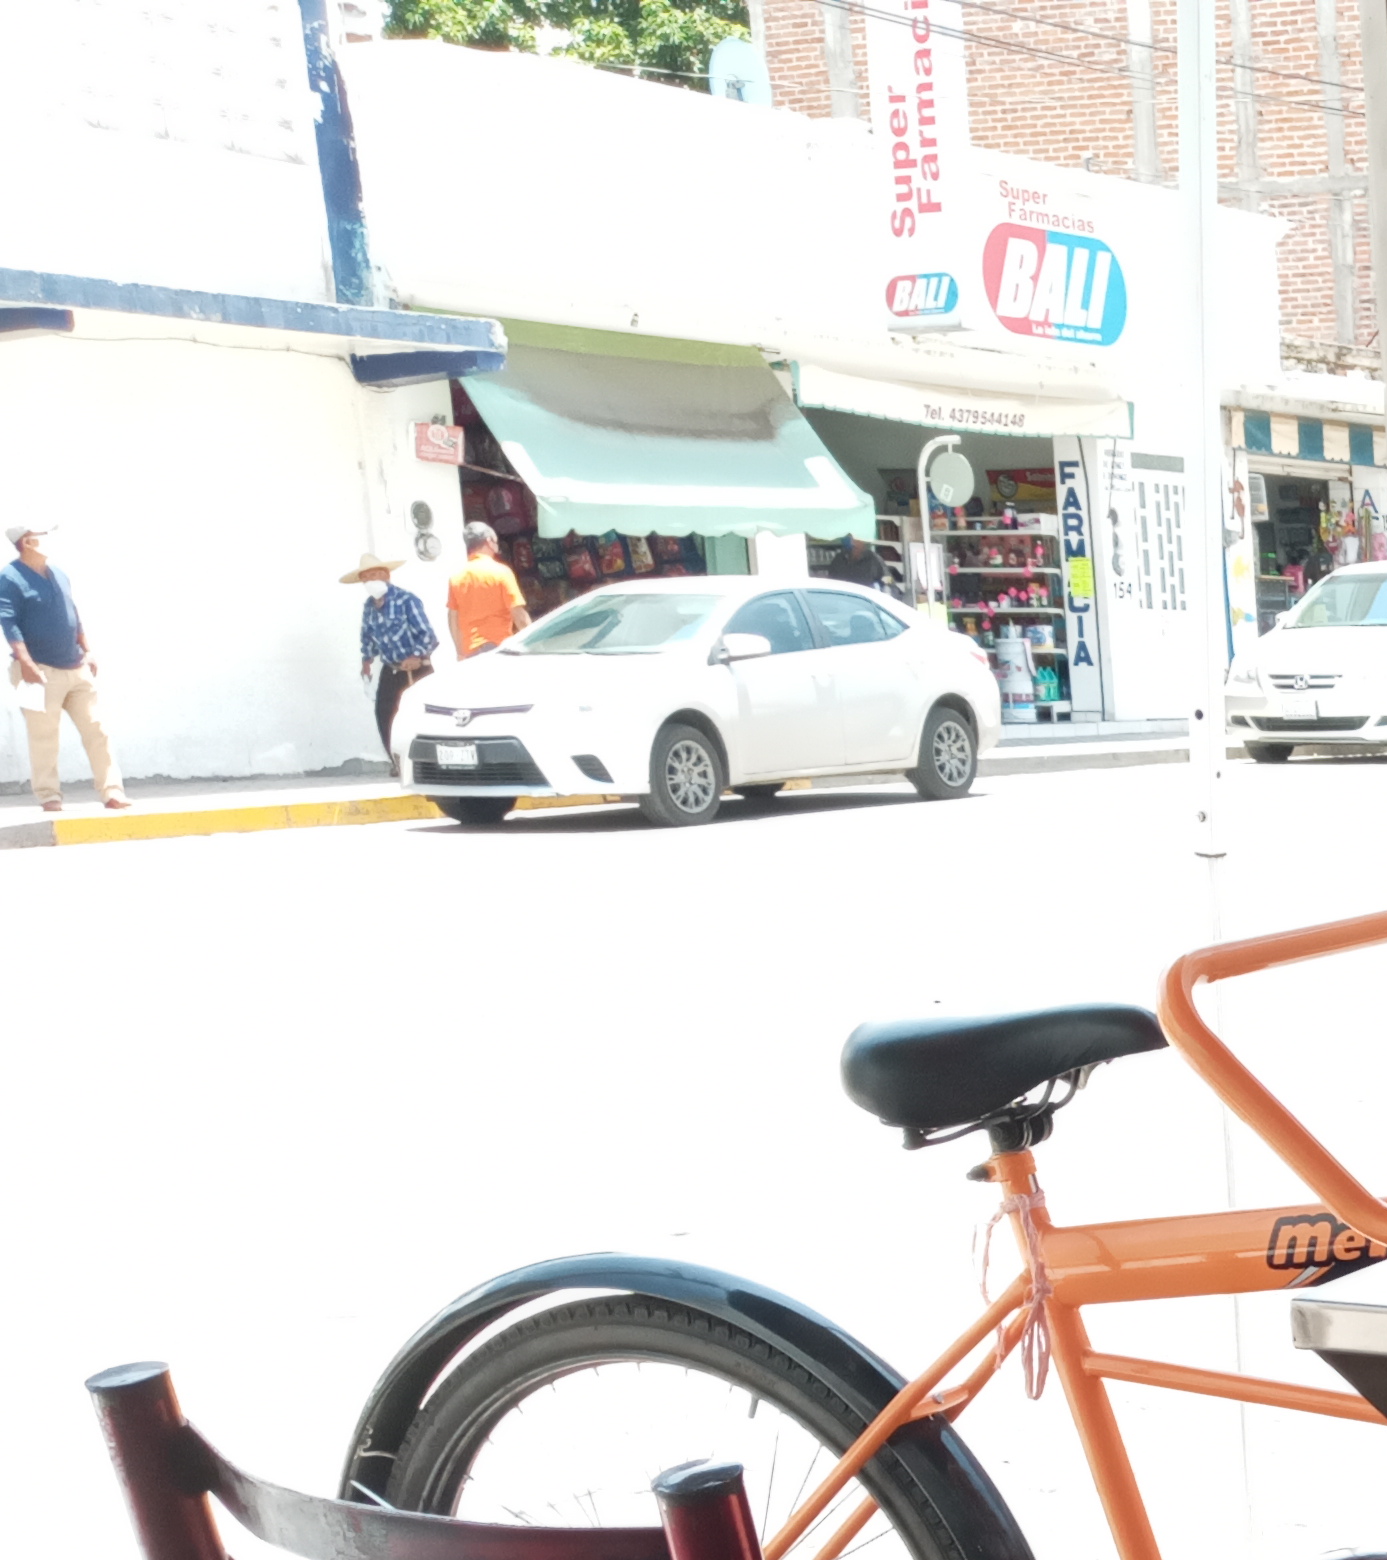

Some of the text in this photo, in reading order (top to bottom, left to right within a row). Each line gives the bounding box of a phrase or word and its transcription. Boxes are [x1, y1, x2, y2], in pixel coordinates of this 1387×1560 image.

[888, 85, 918, 238] Super
[998, 180, 1048, 207] Super
[1007, 202, 1095, 234] Farmacias
[892, 276, 950, 312] BALI
[996, 237, 1112, 329] BALI
[924, 404, 945, 421] Tel.
[1058, 460, 1094, 667] FARMCIA
